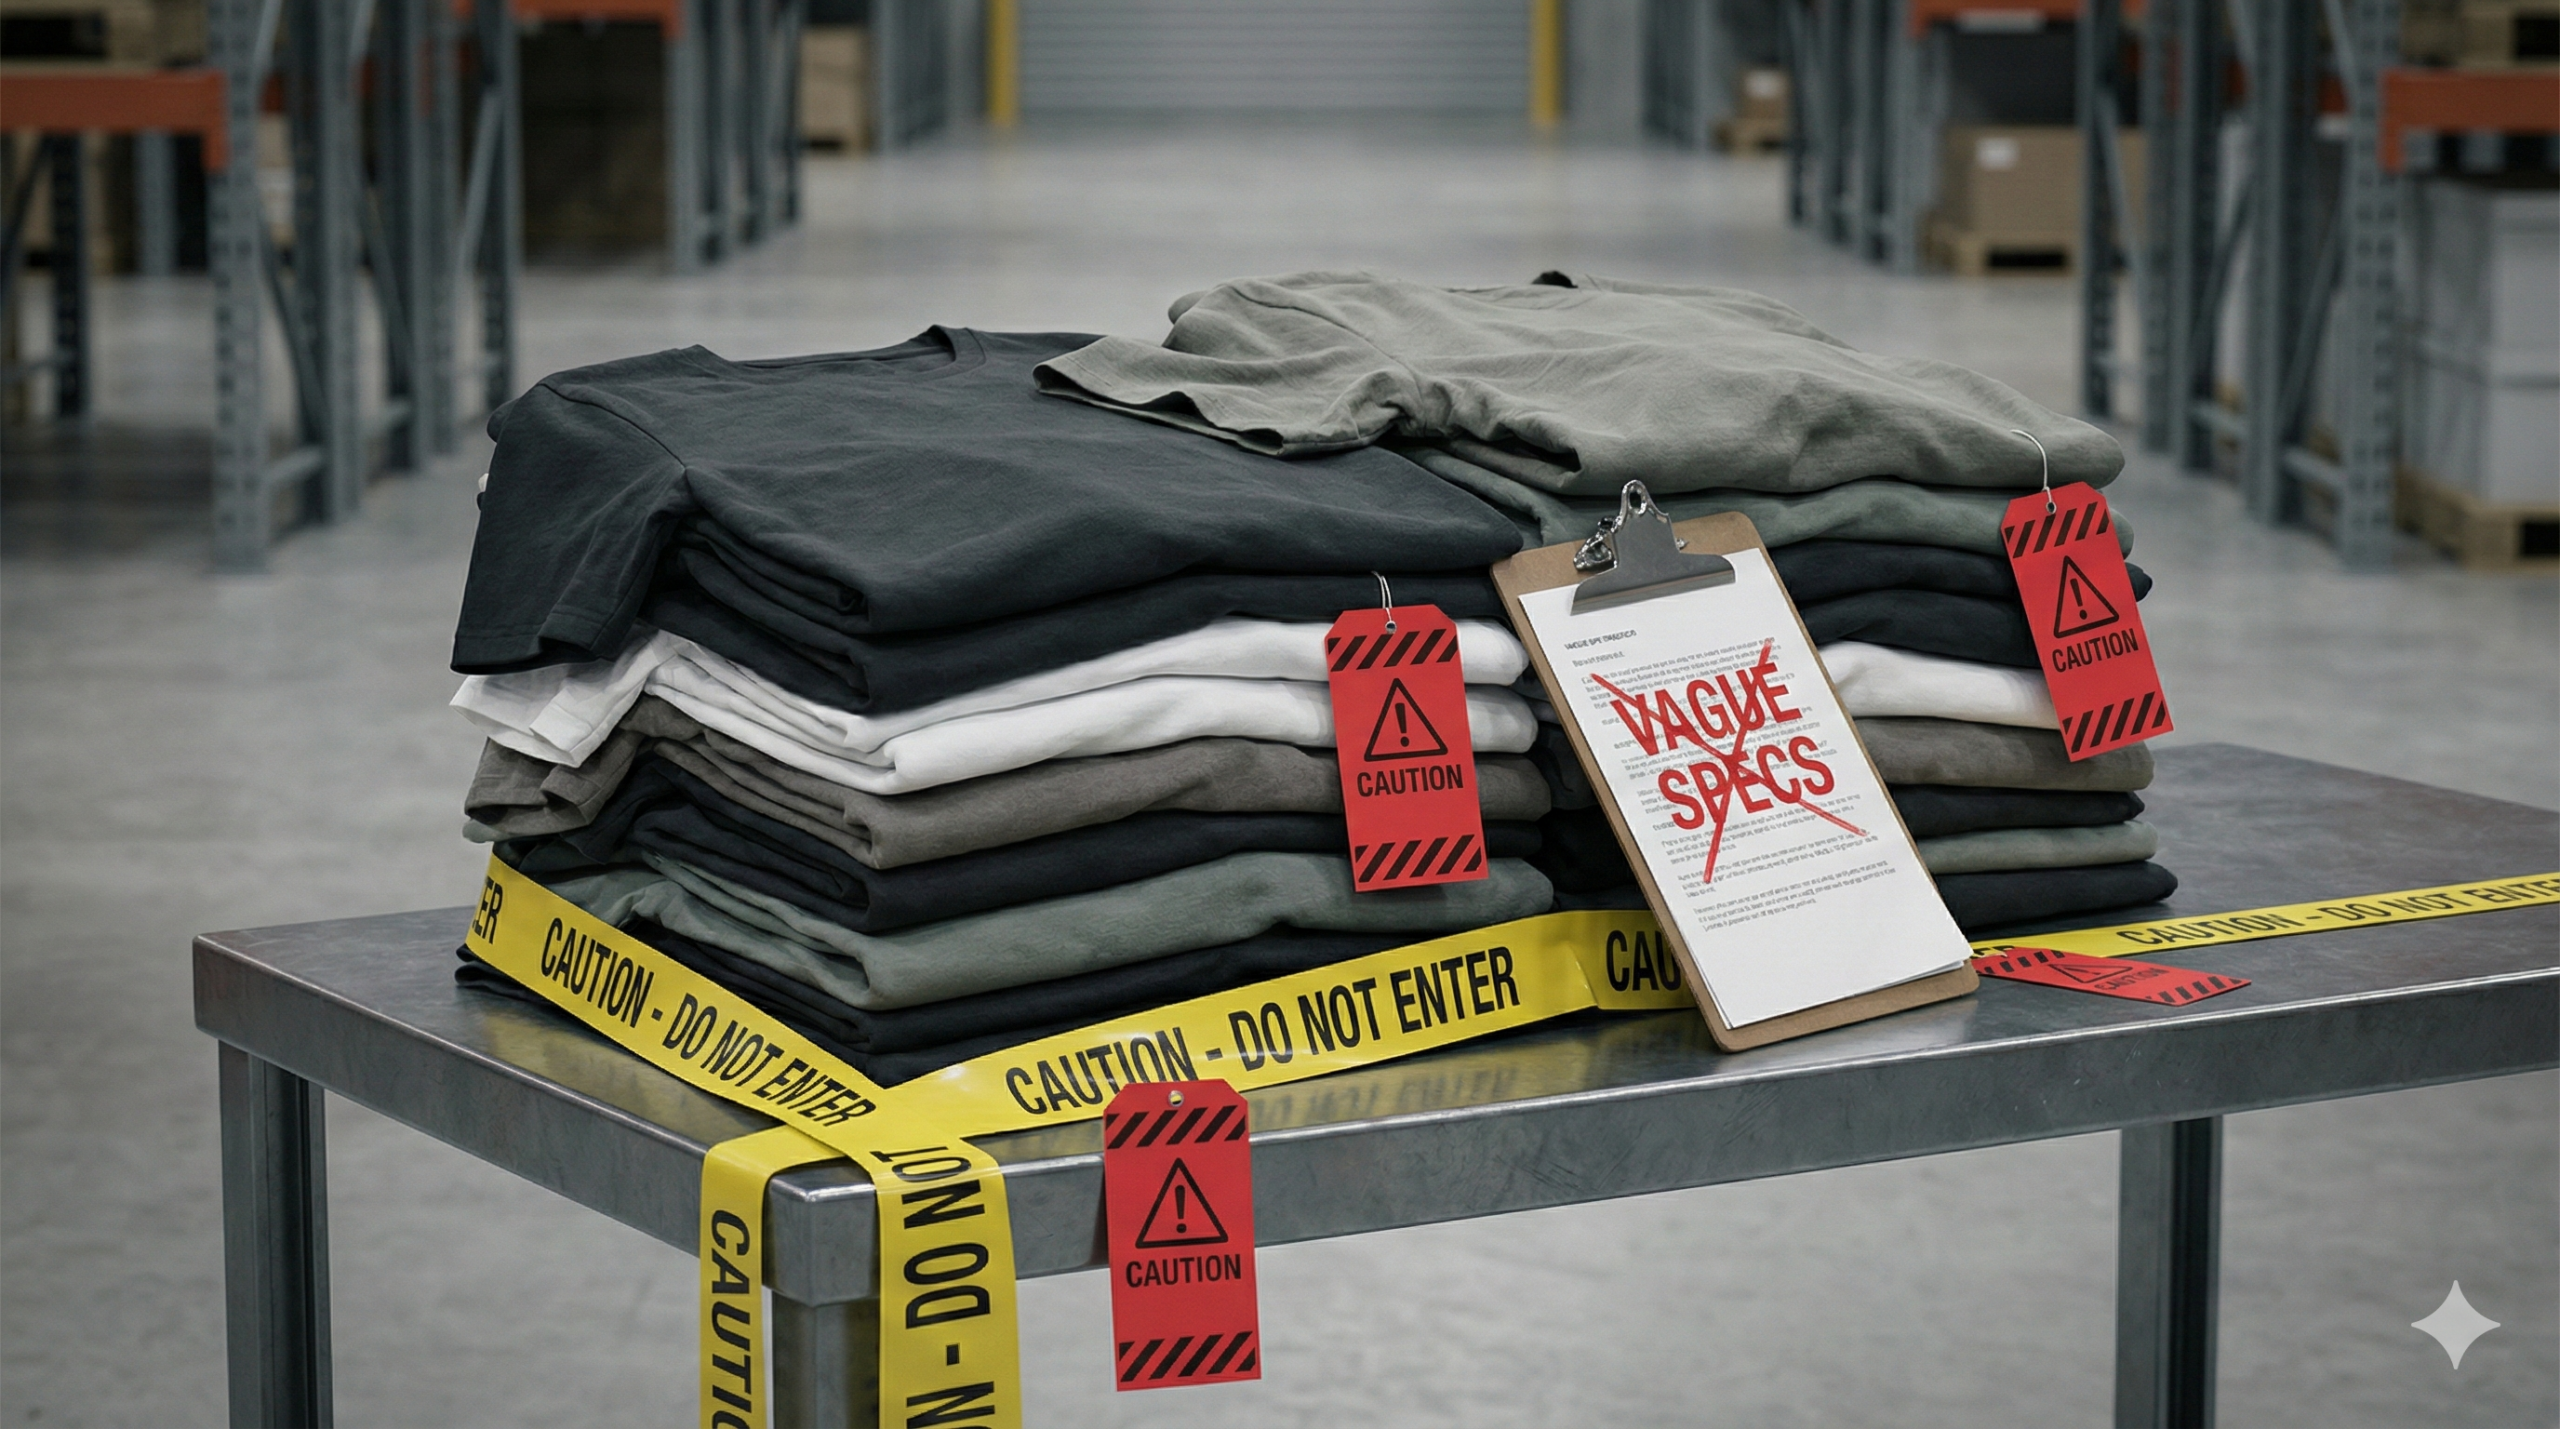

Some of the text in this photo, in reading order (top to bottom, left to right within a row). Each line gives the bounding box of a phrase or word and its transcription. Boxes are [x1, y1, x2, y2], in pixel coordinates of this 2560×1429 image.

[2052, 628, 2139, 673] CAUTION
[1610, 662, 1803, 757] VAGUE
[1357, 764, 1464, 797] CAUTION
[1657, 735, 1835, 830] SPECS
[472, 876, 504, 945] ER
[2116, 913, 2306, 945] CAUTION
[2316, 903, 2392, 921] DO
[2378, 893, 2473, 914] NOT
[541, 917, 655, 1028] CAUTION
[662, 993, 717, 1060] DO
[700, 1020, 785, 1087] NOT
[752, 1057, 877, 1127] ENTER
[1005, 1027, 1199, 1115] CAUTION
[1228, 1002, 1293, 1072] DO
[1297, 977, 1381, 1056] NOT
[1390, 946, 1521, 1034] ENTER
[870, 1146, 986, 1230] NOT
[903, 1243, 991, 1330] DO
[1125, 1253, 1242, 1288] CAUTION
